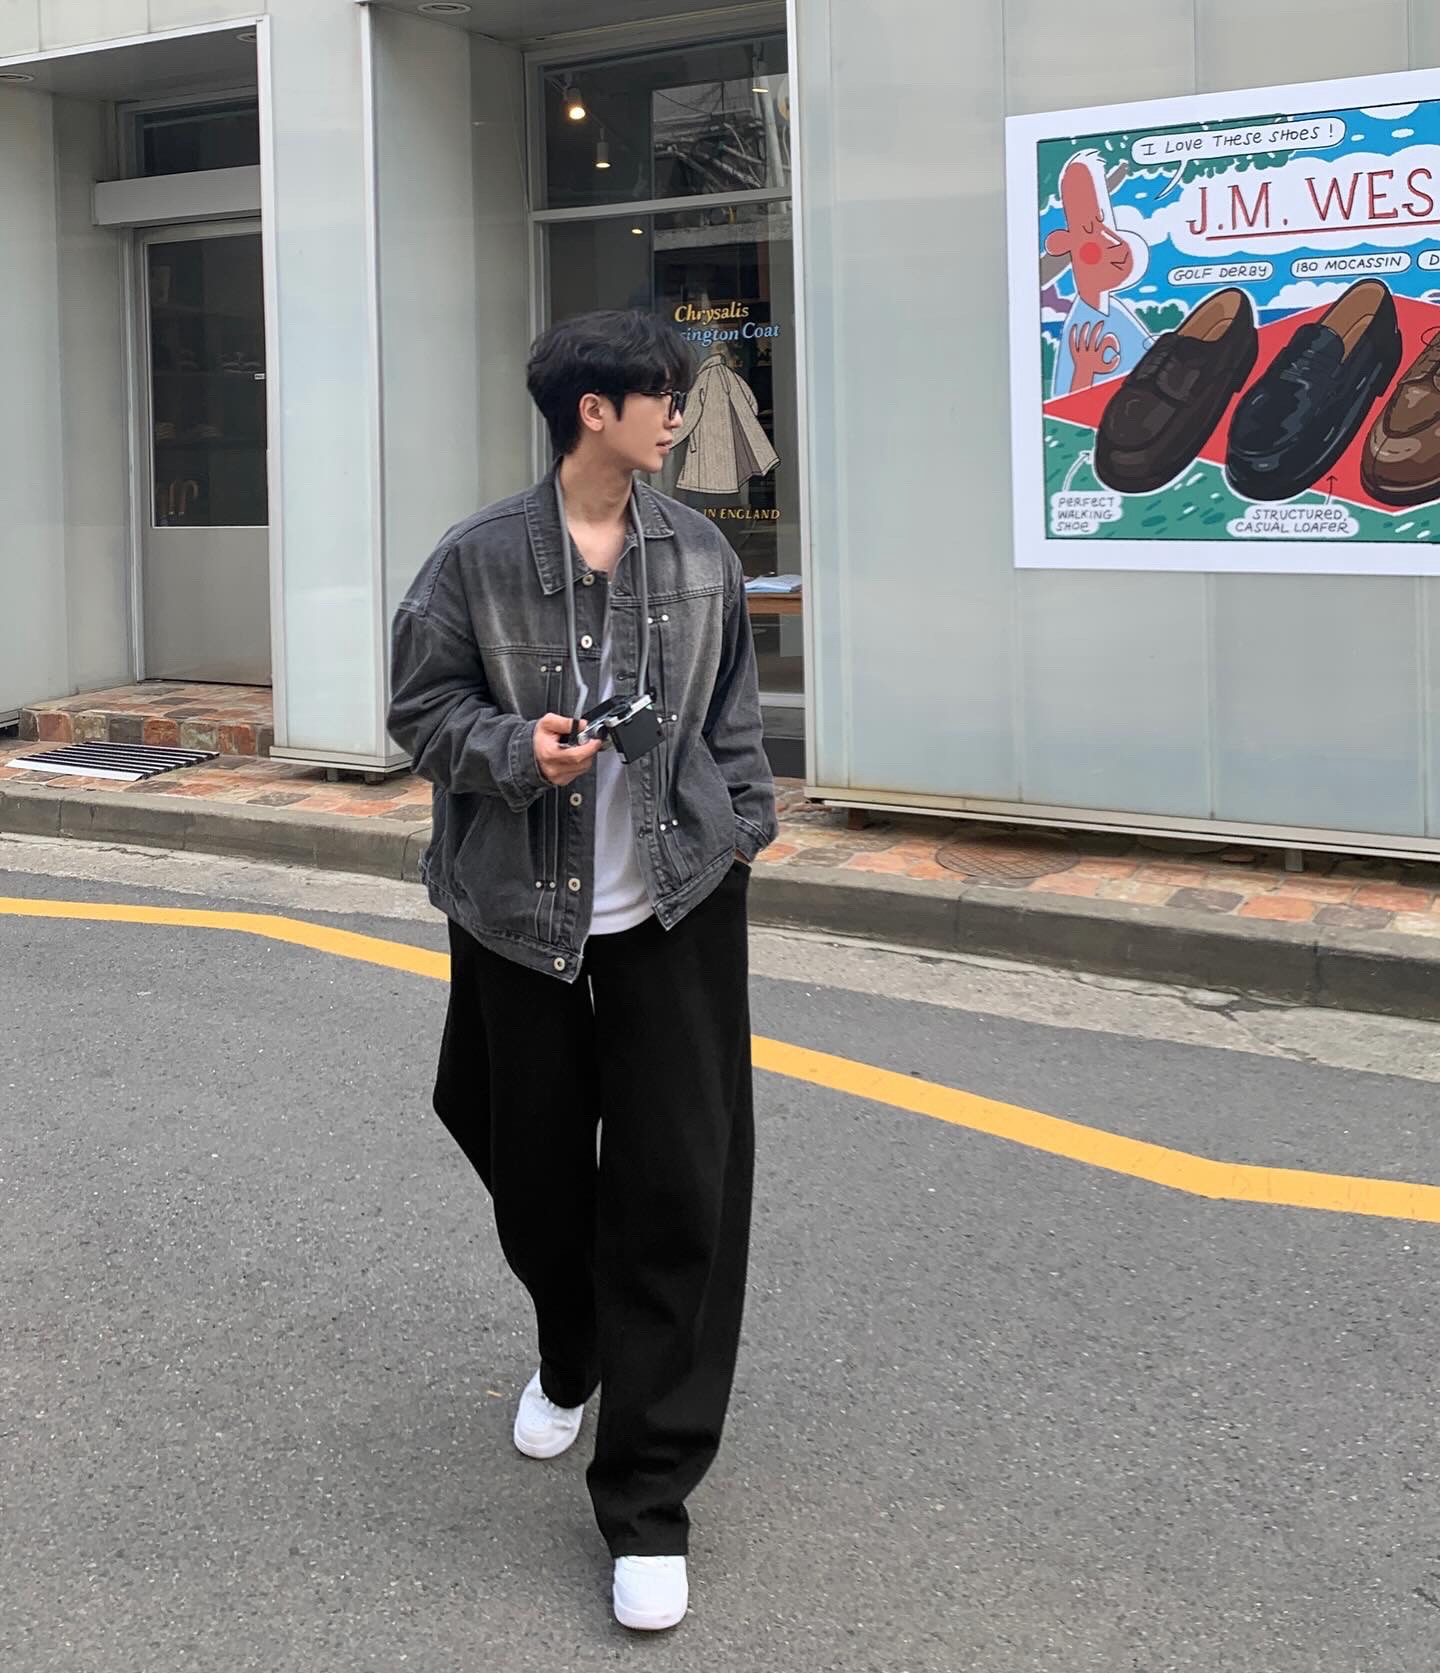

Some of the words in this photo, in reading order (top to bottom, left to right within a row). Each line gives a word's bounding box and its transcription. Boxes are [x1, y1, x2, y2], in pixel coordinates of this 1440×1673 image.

[1141, 143, 1156, 156] I
[1186, 182, 1288, 235] J.M.
[1296, 262, 1318, 273] 180
[1324, 256, 1402, 270] MOCASSIN
[1174, 268, 1213, 281] GOLF
[674, 301, 750, 325] Chrysalis
[742, 321, 780, 339] Coat
[720, 508, 780, 519] ENGLAND
[1058, 509, 1112, 520] WALKING
[1235, 521, 1289, 533] CASUAL
